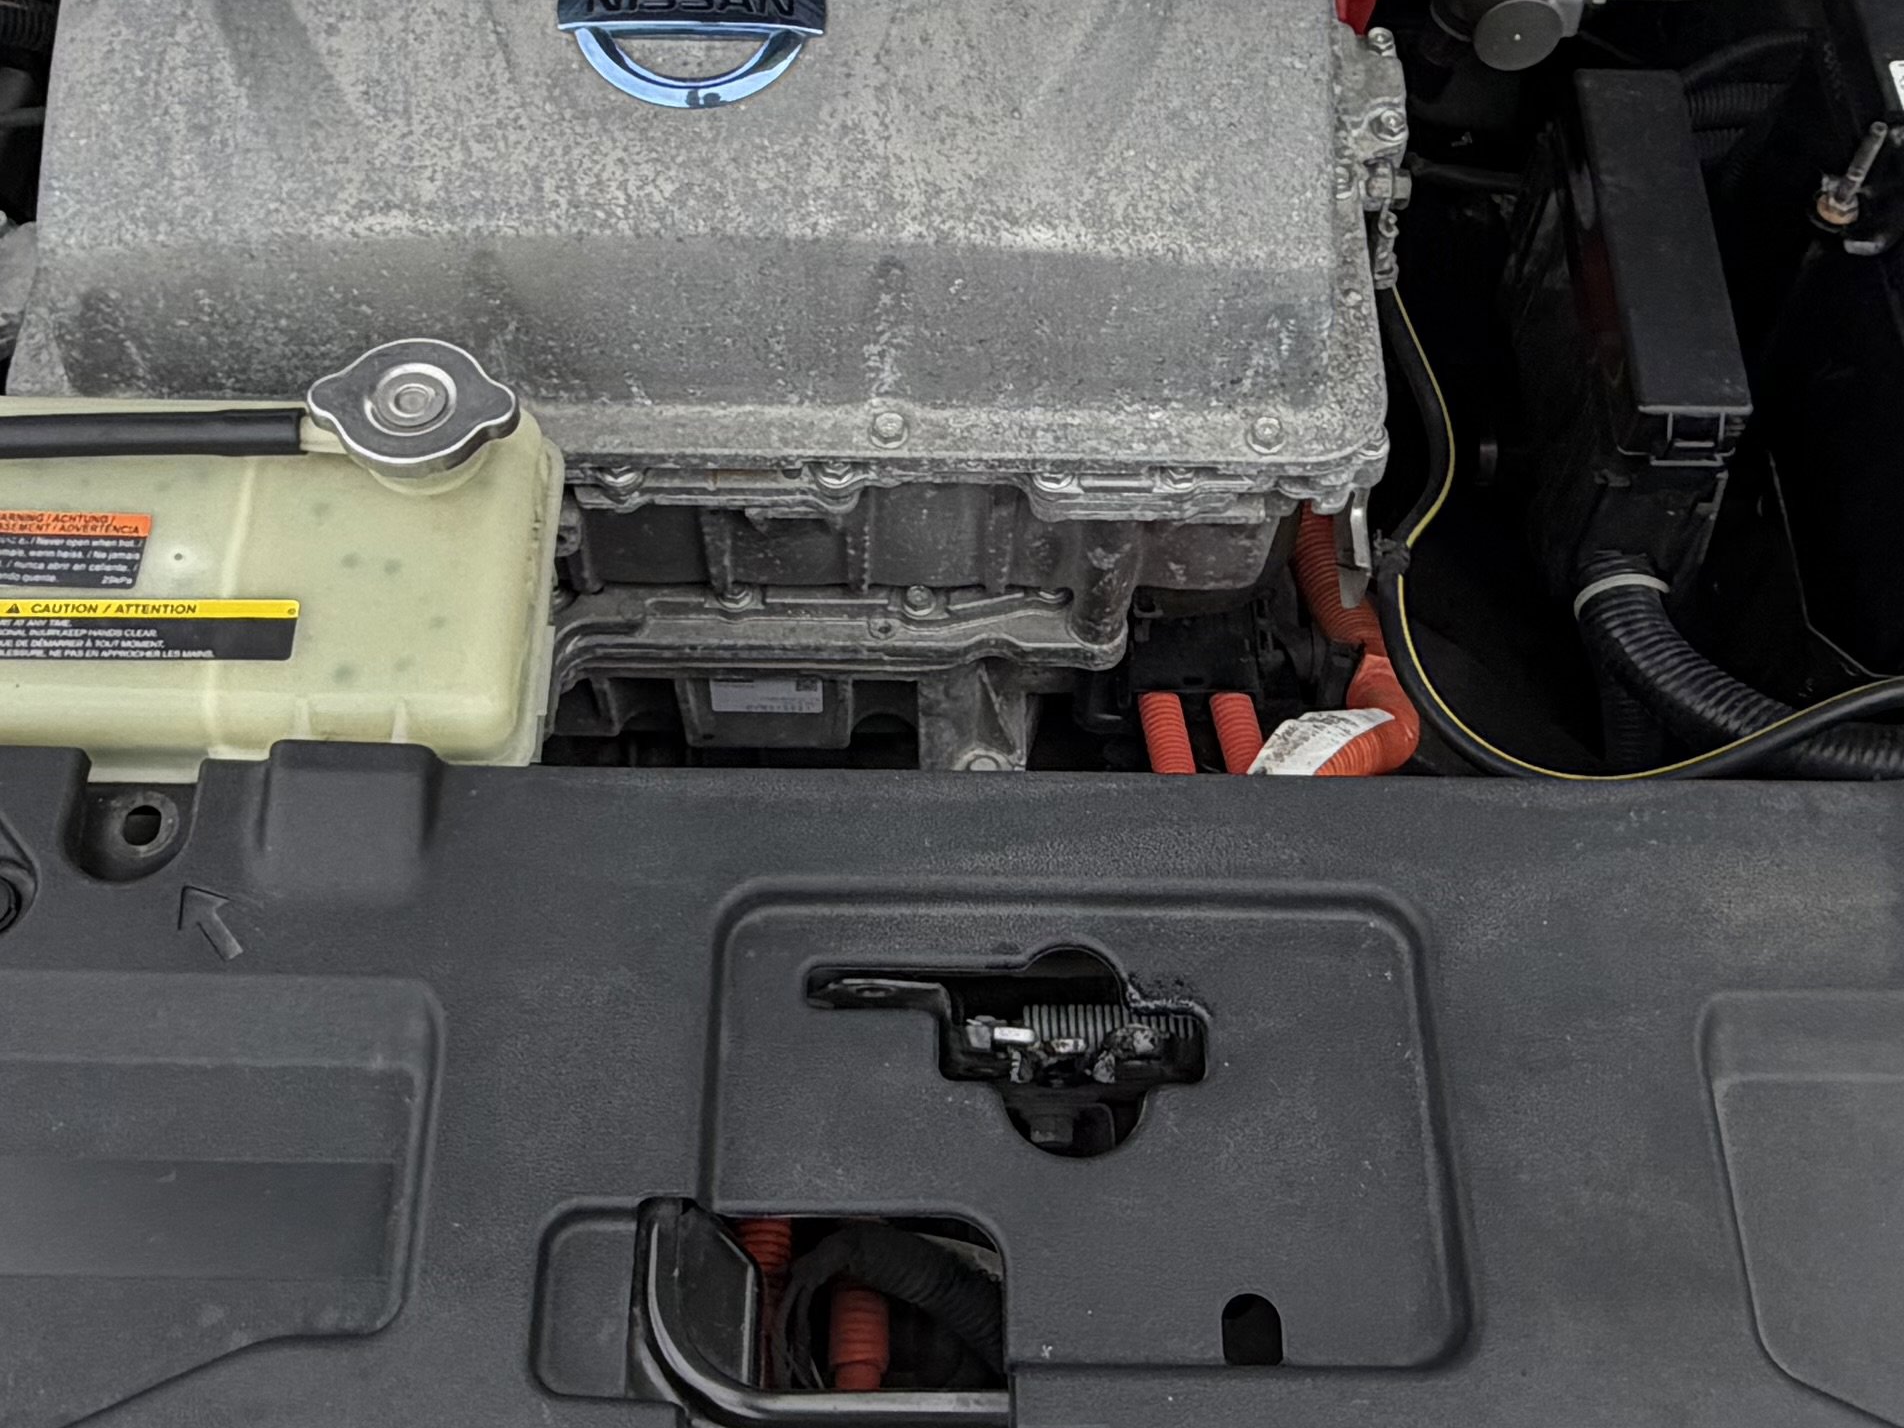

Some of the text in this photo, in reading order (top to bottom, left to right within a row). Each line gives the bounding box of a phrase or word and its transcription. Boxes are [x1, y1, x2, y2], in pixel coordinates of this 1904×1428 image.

[52, 514, 109, 523] ACHTUNG
[30, 603, 99, 614] CAUTION
[115, 604, 197, 615] ATTENTION
[26, 619, 48, 627] ANY
[88, 629, 122, 637] HANDS
[15, 639, 29, 647] DE
[95, 639, 120, 648] TOUT
[48, 649, 63, 657] NE
[64, 649, 84, 657] PAS
[85, 649, 99, 658] EN
[100, 649, 161, 658] APPROCHER
[162, 650, 181, 658] LES
